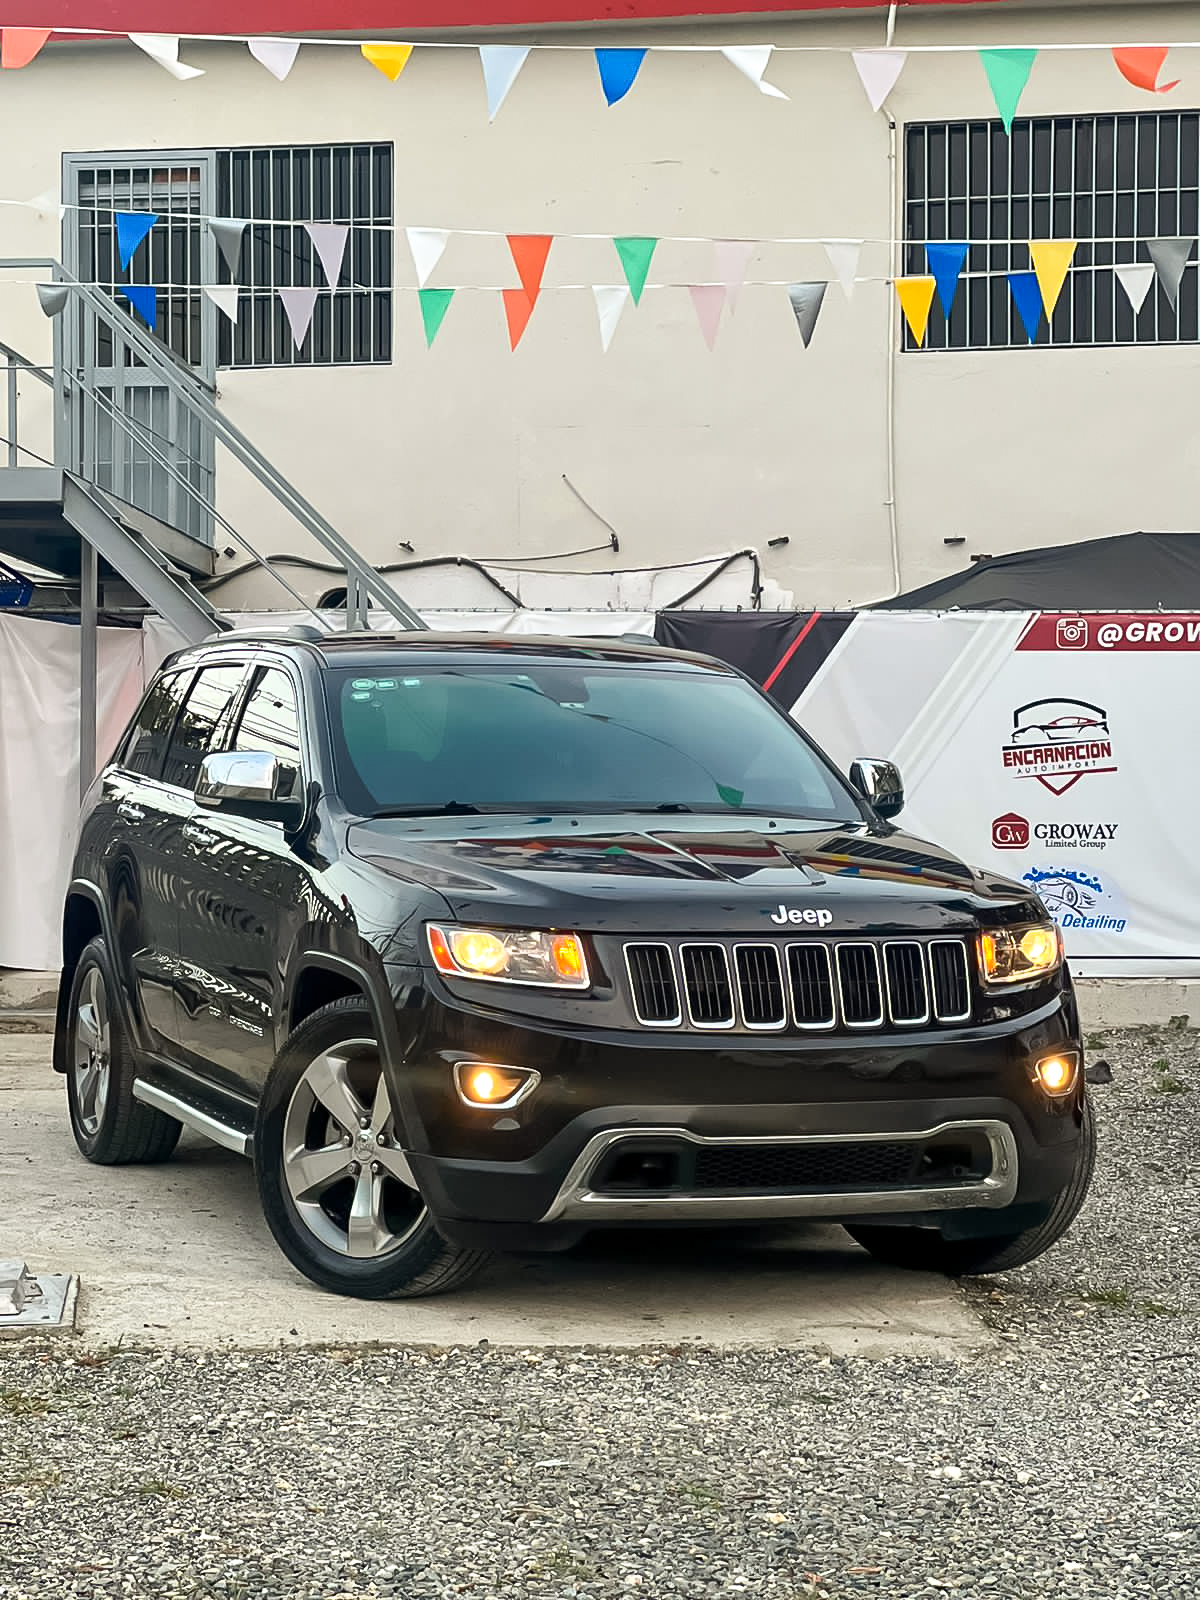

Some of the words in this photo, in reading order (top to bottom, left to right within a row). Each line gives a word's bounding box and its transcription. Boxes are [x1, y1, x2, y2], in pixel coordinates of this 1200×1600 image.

[1017, 765, 1047, 774] AUTO
[1052, 760, 1097, 770] IMPORT
[1034, 824, 1118, 839] GROWAY
[1045, 840, 1077, 848] Limited
[1079, 840, 1106, 850] Group
[770, 904, 833, 928] Jeep
[1062, 914, 1126, 932] Detailing
